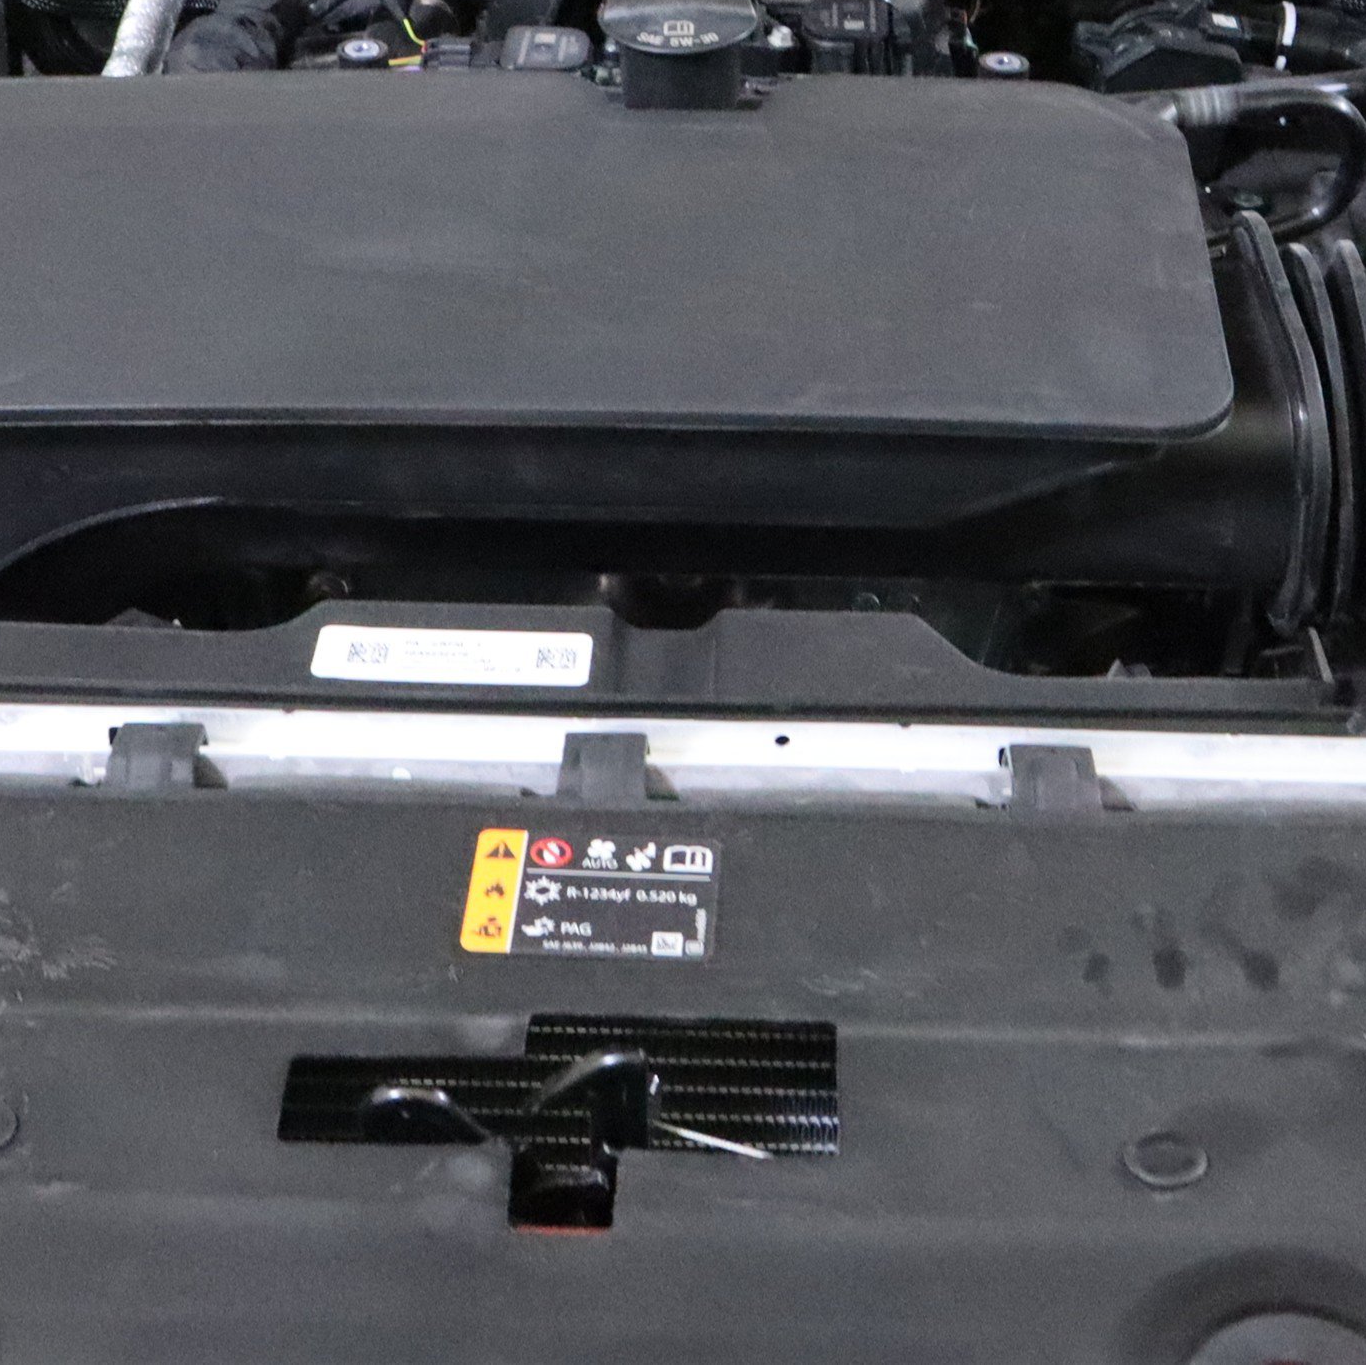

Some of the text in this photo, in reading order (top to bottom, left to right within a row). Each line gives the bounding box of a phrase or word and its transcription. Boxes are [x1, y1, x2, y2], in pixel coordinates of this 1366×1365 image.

[566, 885, 631, 904] R-1234yf
[679, 891, 698, 907] kg
[560, 921, 592, 937] PAG
